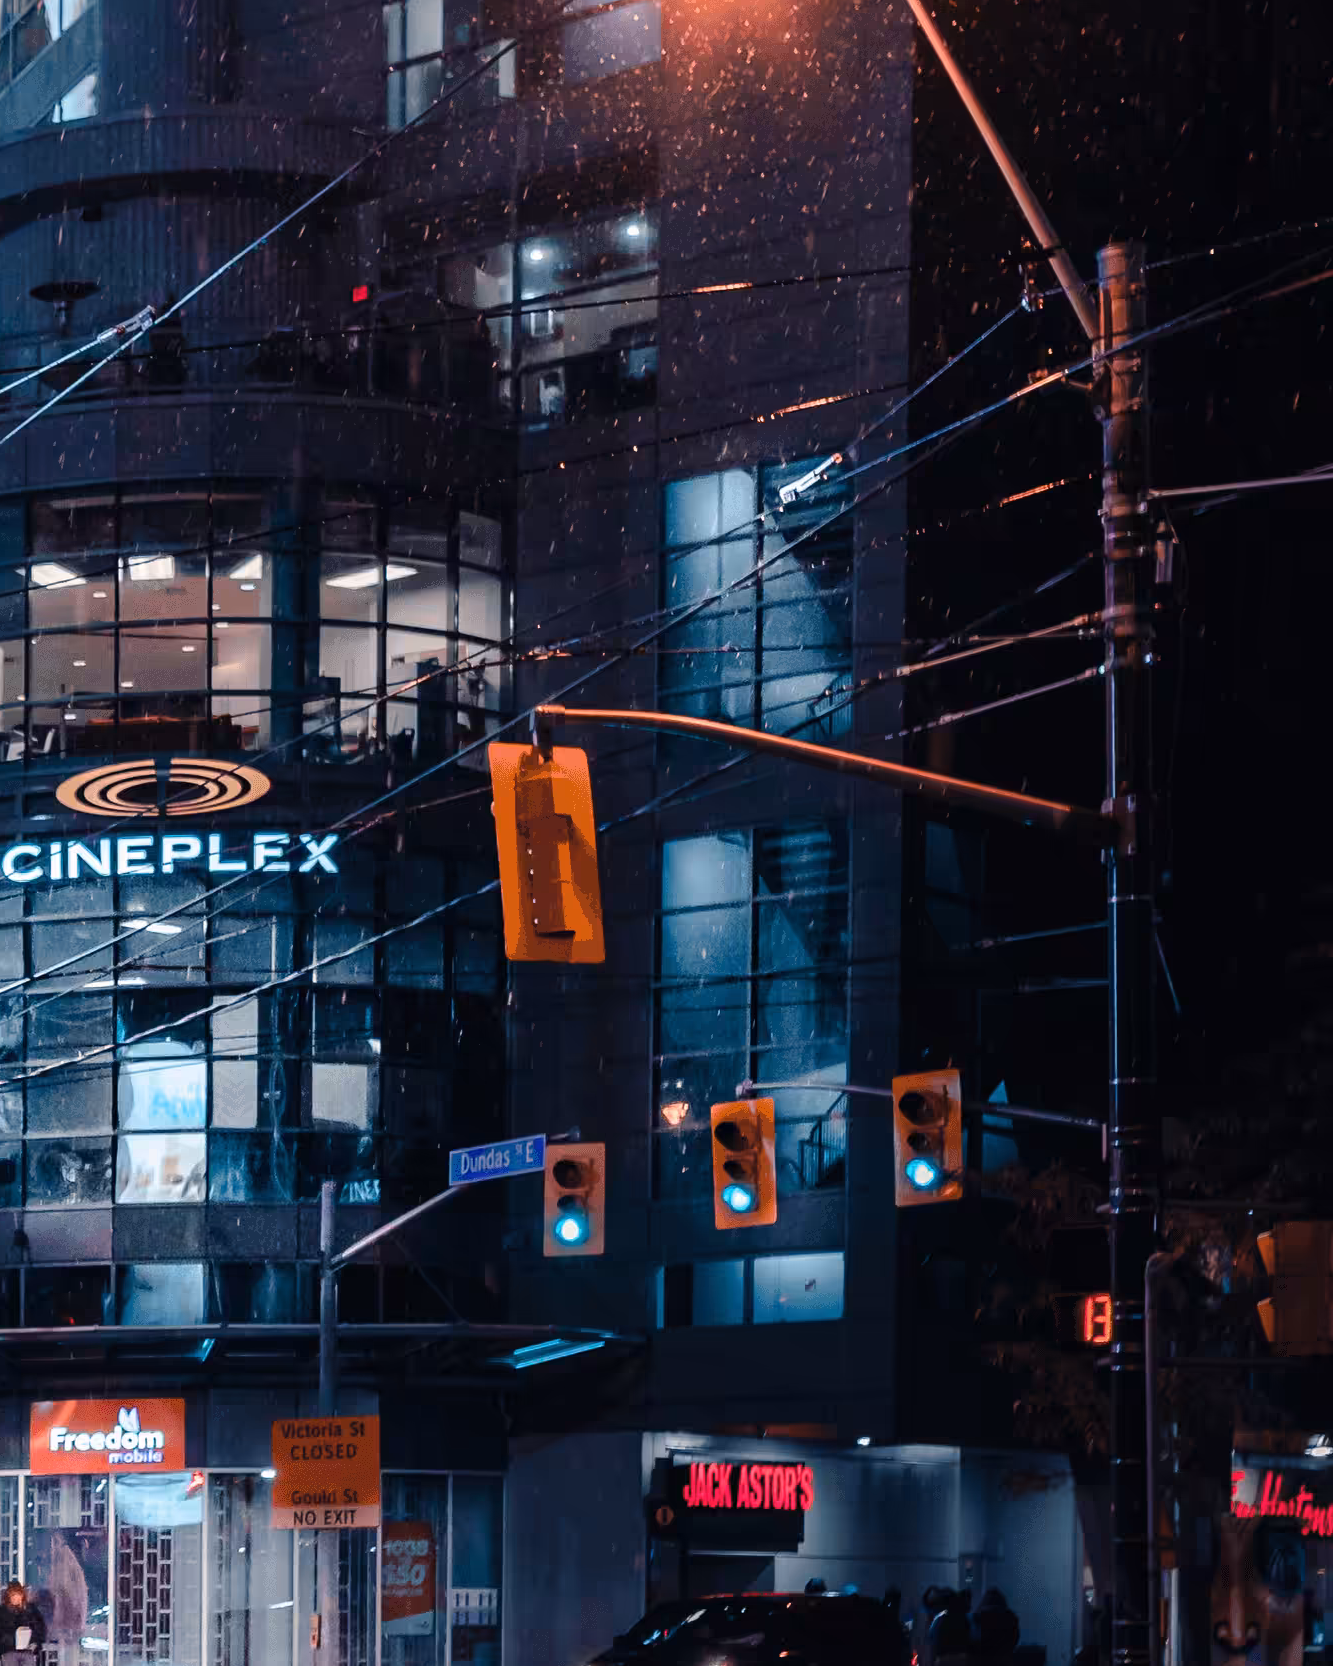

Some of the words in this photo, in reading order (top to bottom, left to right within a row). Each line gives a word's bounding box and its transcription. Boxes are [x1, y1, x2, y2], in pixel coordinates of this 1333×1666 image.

[1, 832, 339, 883] CINEPLEX
[461, 1148, 510, 1175] Dundas
[526, 1141, 534, 1163] E
[49, 1425, 165, 1451] Freedom
[281, 1422, 342, 1440] Victoria
[349, 1421, 366, 1437] St
[108, 1449, 164, 1465] mobile
[290, 1444, 358, 1461] CLOSED
[683, 1462, 733, 1509] JACK
[737, 1462, 813, 1511] ASTOR'S
[291, 1489, 337, 1505] Gould
[343, 1488, 359, 1504] St
[293, 1510, 316, 1525] NO
[324, 1509, 357, 1525] EXIT
